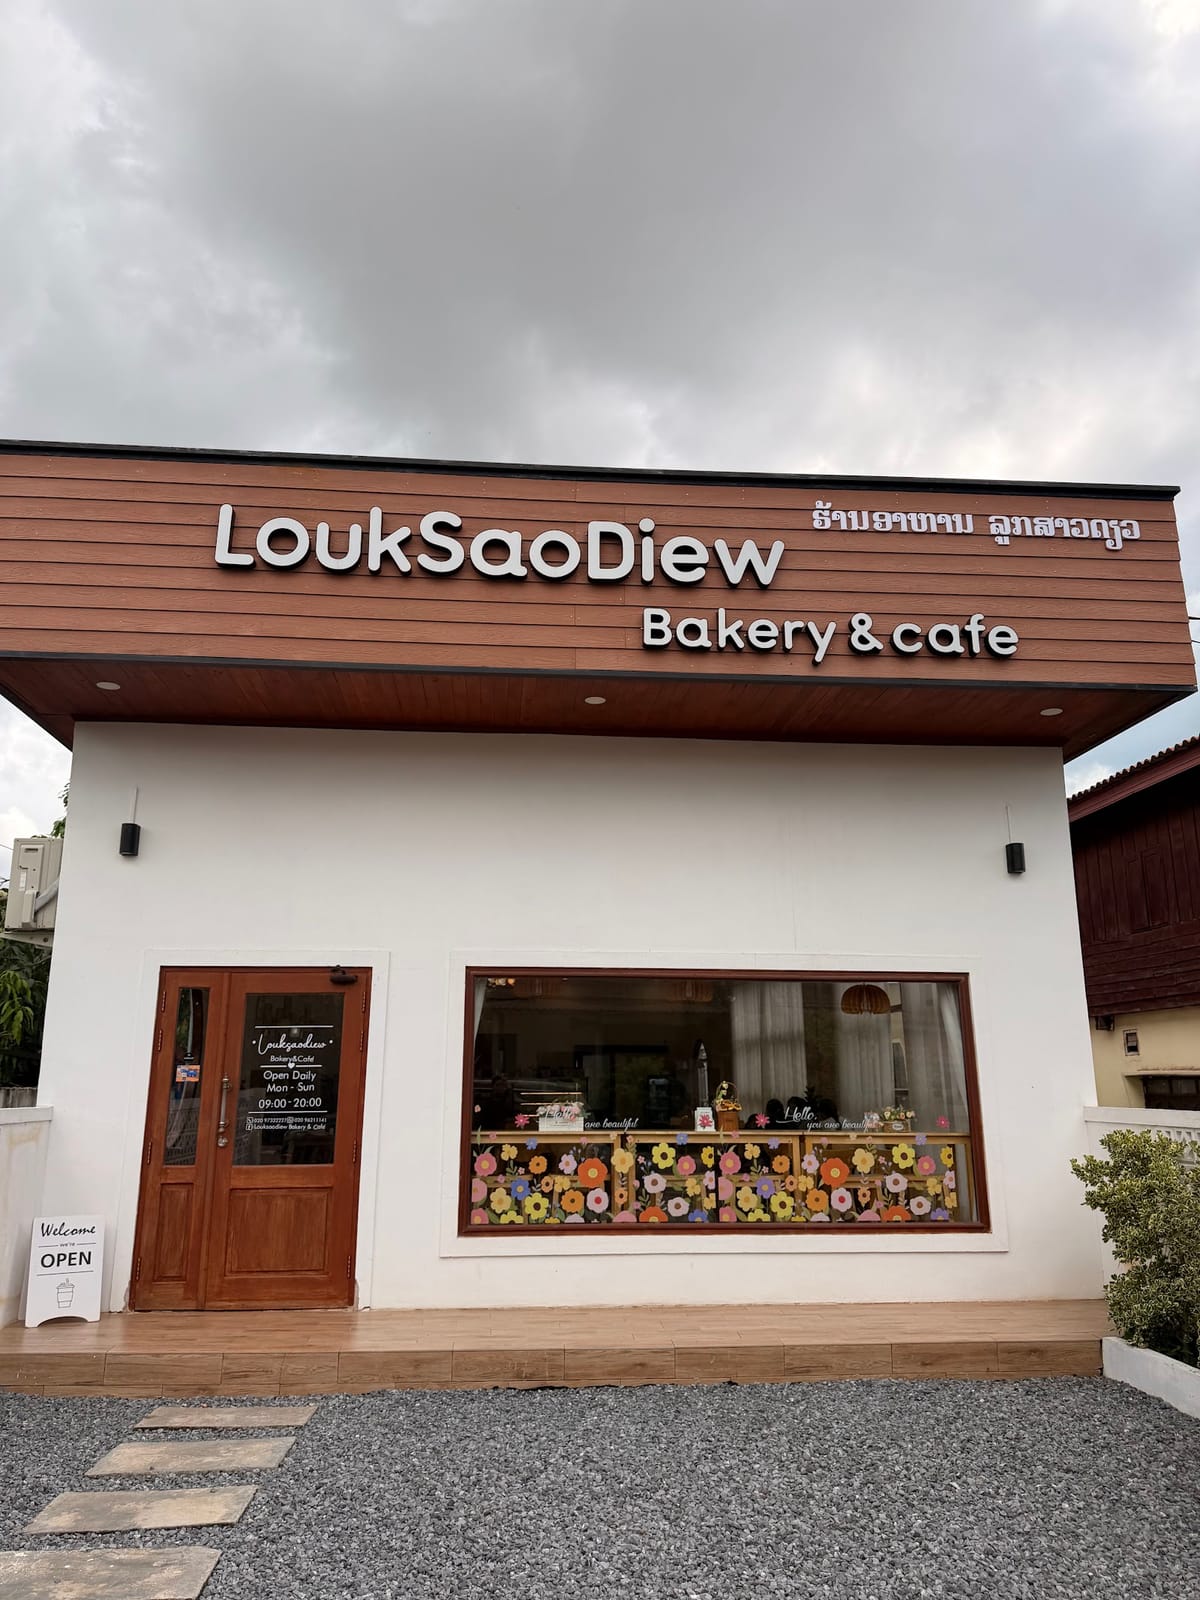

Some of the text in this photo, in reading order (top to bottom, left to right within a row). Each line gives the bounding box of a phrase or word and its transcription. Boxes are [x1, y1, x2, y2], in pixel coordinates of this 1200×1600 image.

[214, 503, 786, 588] LoukSaoDiew
[642, 607, 1020, 665] Bakery & cafe
[263, 1070, 317, 1083] Open Daily
[266, 1083, 289, 1093] Mon
[297, 1082, 315, 1092] Sun
[258, 1098, 287, 1109] 09:00
[293, 1097, 322, 1108] 20:00
[584, 1121, 601, 1129] are
[602, 1117, 640, 1133] beautiful
[806, 1121, 822, 1133] you
[41, 1221, 96, 1238] Welcome
[40, 1251, 92, 1268] OPEN
